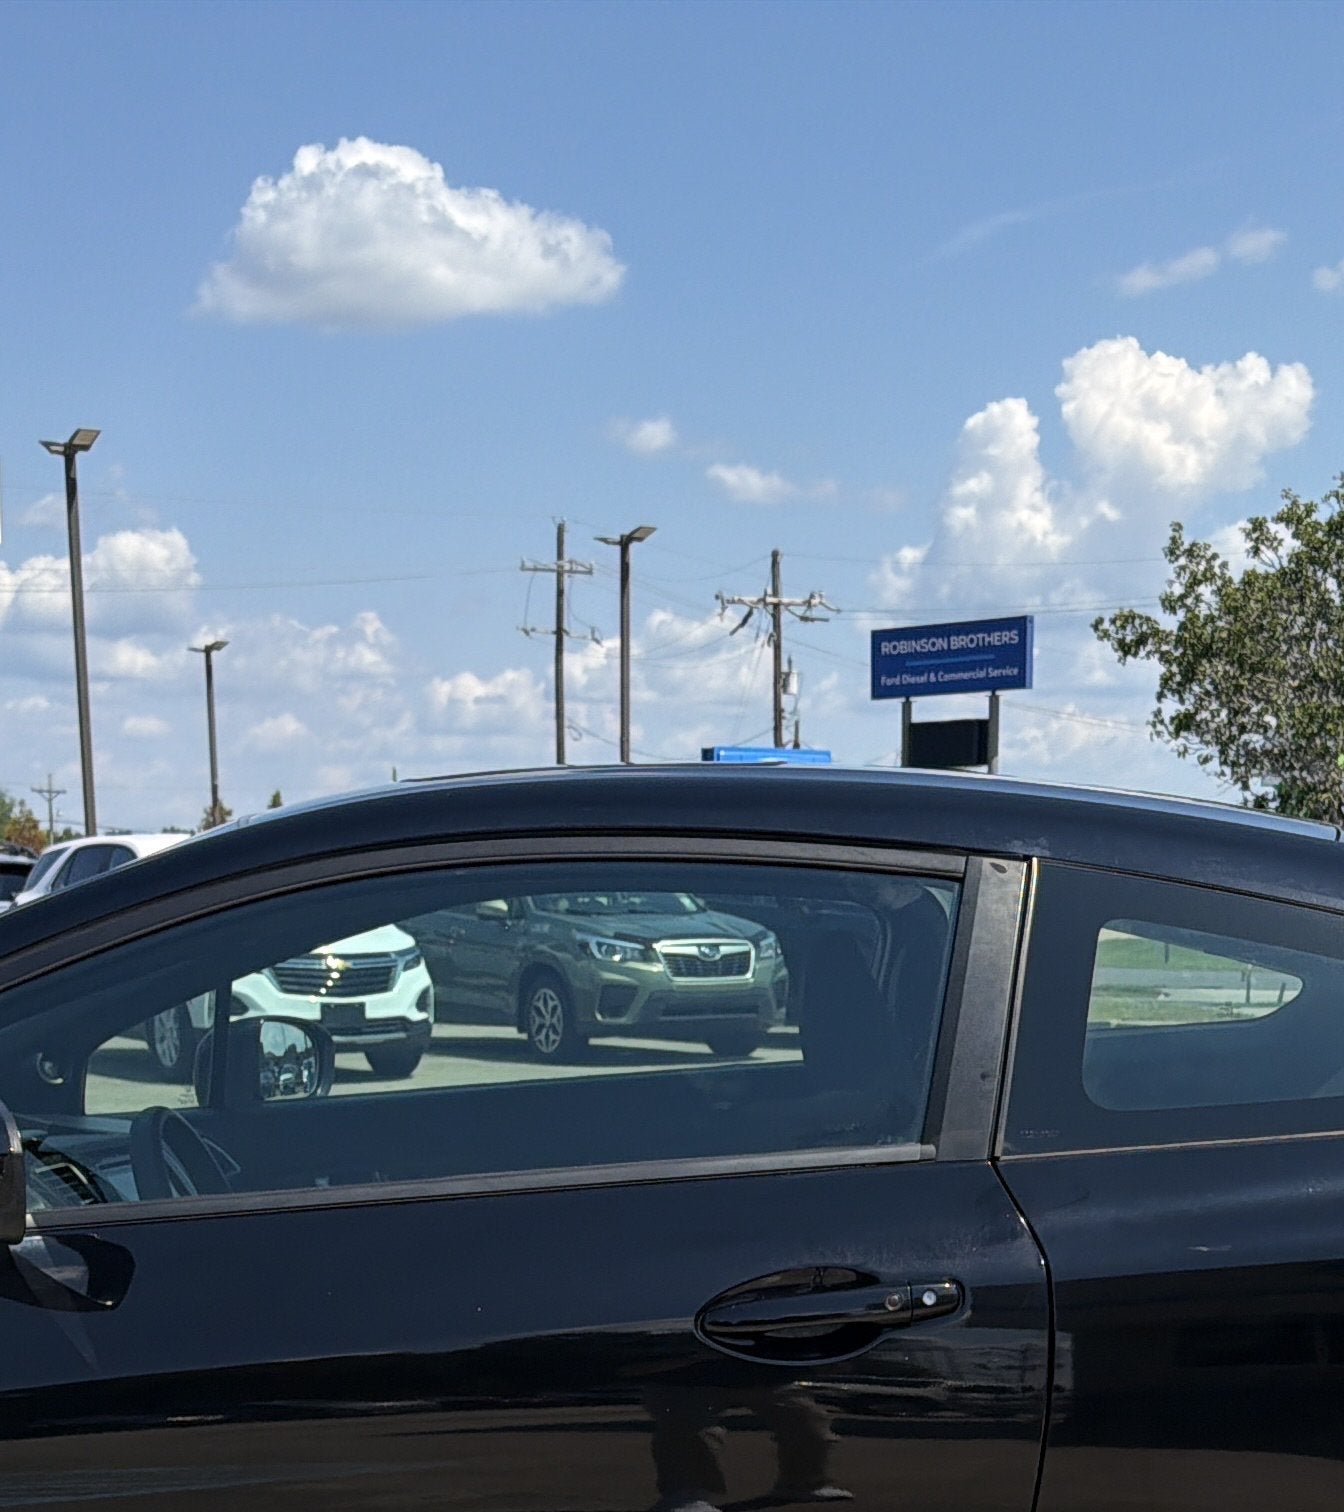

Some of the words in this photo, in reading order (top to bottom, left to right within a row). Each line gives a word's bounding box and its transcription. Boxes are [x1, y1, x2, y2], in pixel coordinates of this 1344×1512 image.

[880, 637, 948, 656] ROBINSON
[950, 630, 1019, 650] BROTHERS
[880, 675, 901, 686] Ford
[902, 671, 928, 685] Diesel
[929, 671, 936, 682] &
[937, 668, 987, 682] Commercial
[988, 665, 1018, 677] Service
